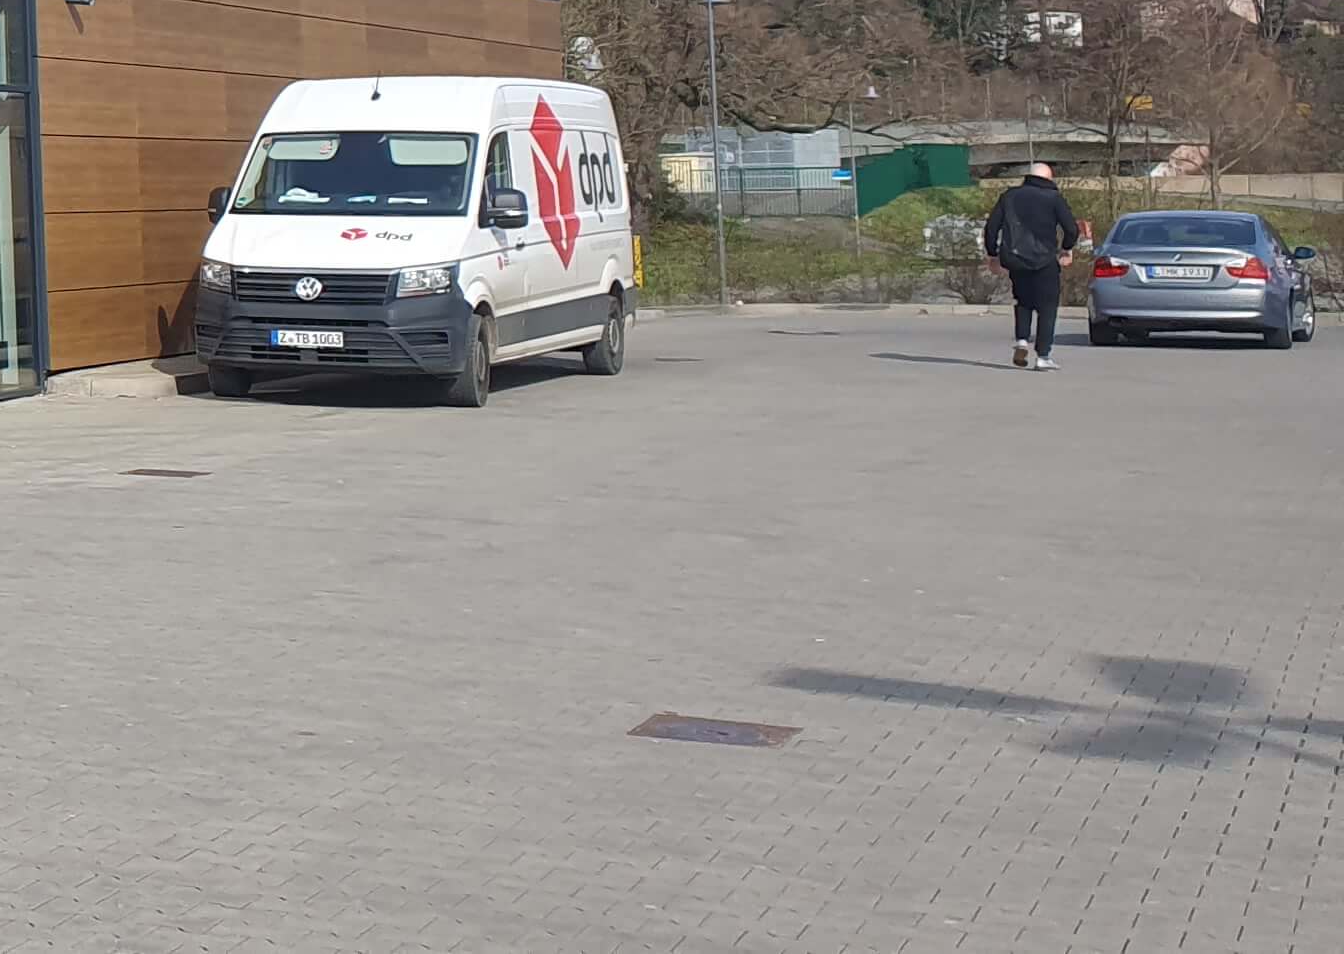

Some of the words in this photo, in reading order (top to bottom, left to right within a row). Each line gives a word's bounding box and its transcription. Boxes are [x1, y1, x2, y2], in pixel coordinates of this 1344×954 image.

[579, 130, 616, 223] dpd
[375, 230, 412, 242] dpd
[295, 332, 310, 344] TB
[312, 333, 342, 345] 1003
